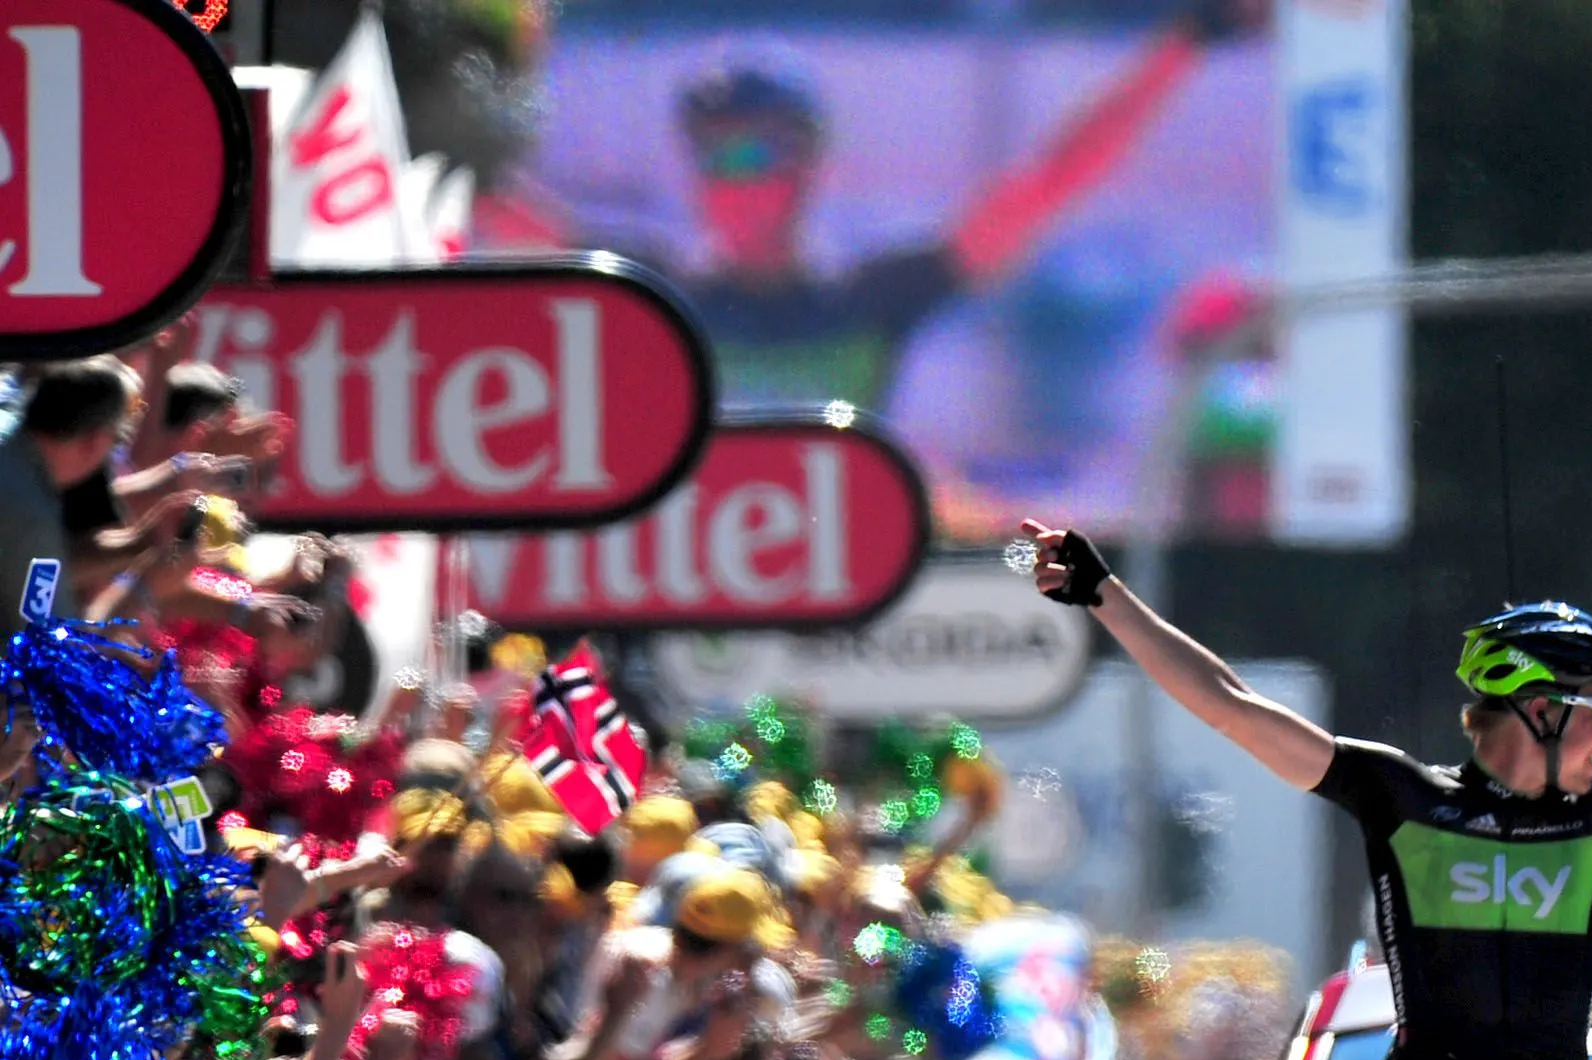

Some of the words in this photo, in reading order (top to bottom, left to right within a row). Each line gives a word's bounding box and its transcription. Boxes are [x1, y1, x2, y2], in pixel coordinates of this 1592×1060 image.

[1505, 649, 1535, 673] sky
[1486, 779, 1514, 799] sky
[1377, 873, 1397, 942] HAGEN
[1449, 853, 1572, 919] sky
